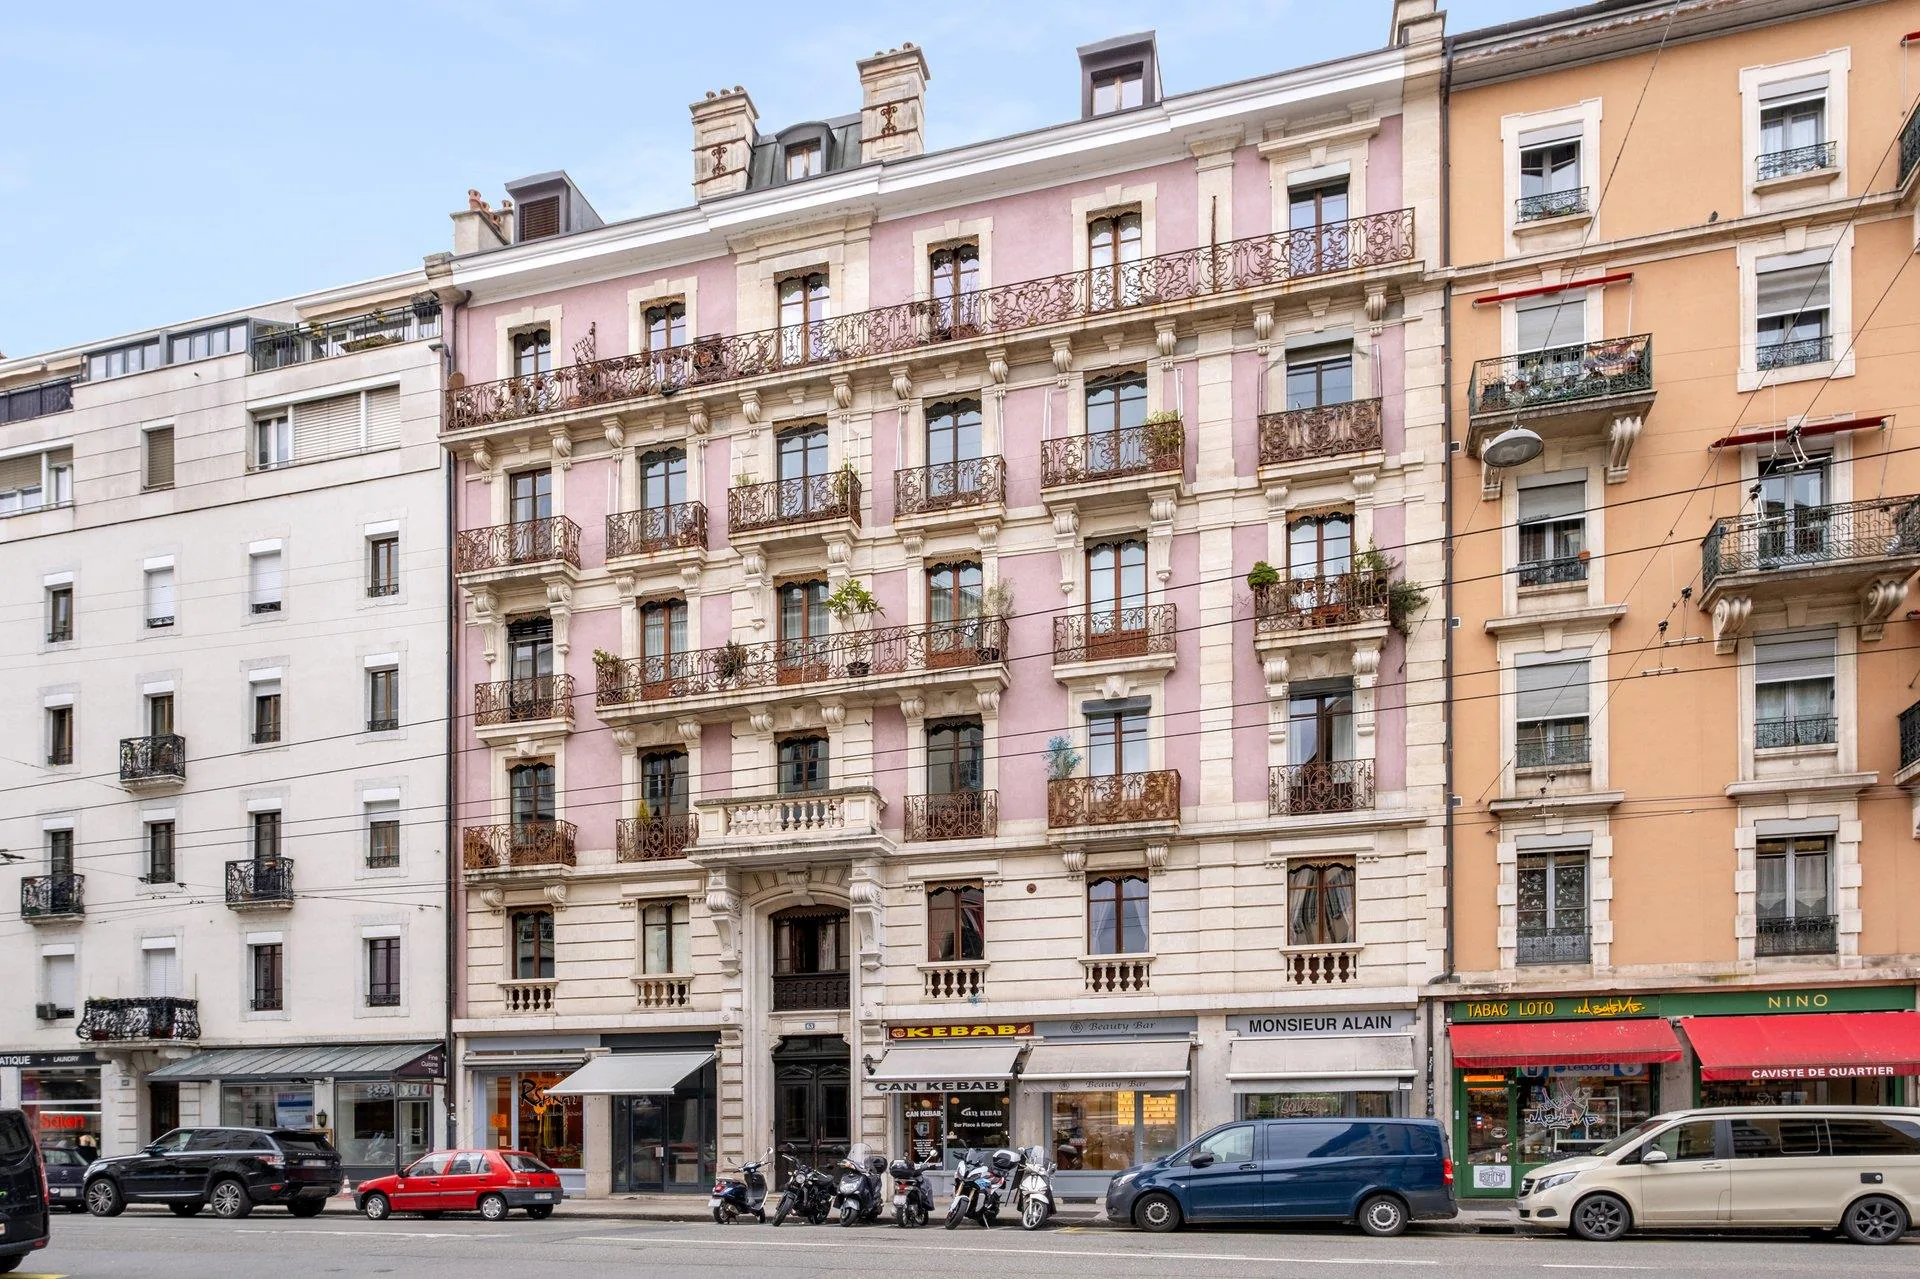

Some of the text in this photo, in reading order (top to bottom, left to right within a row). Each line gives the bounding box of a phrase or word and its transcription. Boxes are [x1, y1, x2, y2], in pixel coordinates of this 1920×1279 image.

[1768, 994, 1828, 1009] NINO
[1467, 1002, 1555, 1017] TABAC LOTO
[1089, 1021, 1156, 1031] Beauty Bar
[1249, 1015, 1392, 1032] MONSIEUR ALAIN
[906, 1024, 1017, 1038] KEBAB
[1752, 1066, 1894, 1078] CAVISTE DE QUARTIER
[875, 1081, 999, 1091] CAN KEBAB
[1085, 1080, 1122, 1090] Beauty
[41, 1113, 85, 1129] Salon
